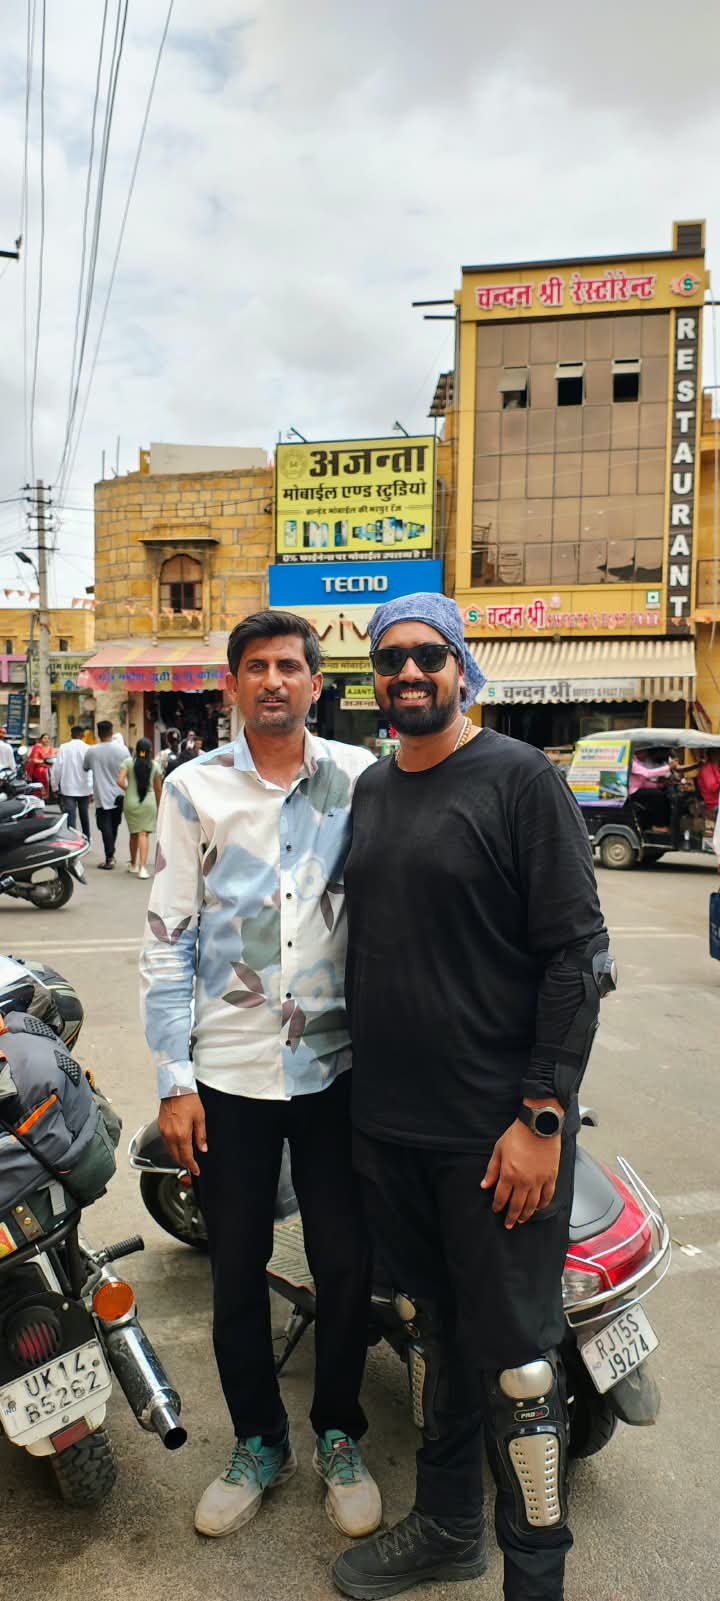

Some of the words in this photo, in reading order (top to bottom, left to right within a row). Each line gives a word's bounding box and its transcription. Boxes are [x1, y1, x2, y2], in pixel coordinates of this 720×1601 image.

[477, 284, 532, 309] चन्दन
[539, 275, 563, 307] श्री
[310, 446, 429, 477] अजन्ता
[670, 317, 695, 617] RESTAURANT
[283, 483, 337, 501] मोबाईल
[342, 485, 373, 498] एण्ड
[376, 479, 426, 502] स्टुडियो
[321, 575, 388, 593] TECNO
[308, 612, 368, 641] viv
[487, 605, 524, 627] चन्दन
[527, 599, 545, 629] श्री
[347, 688, 374, 696] AJANT
[504, 686, 544, 699] चन्दन
[550, 681, 571, 699] श्री
[595, 1313, 639, 1359] RJ15S
[608, 1334, 649, 1379] J9274
